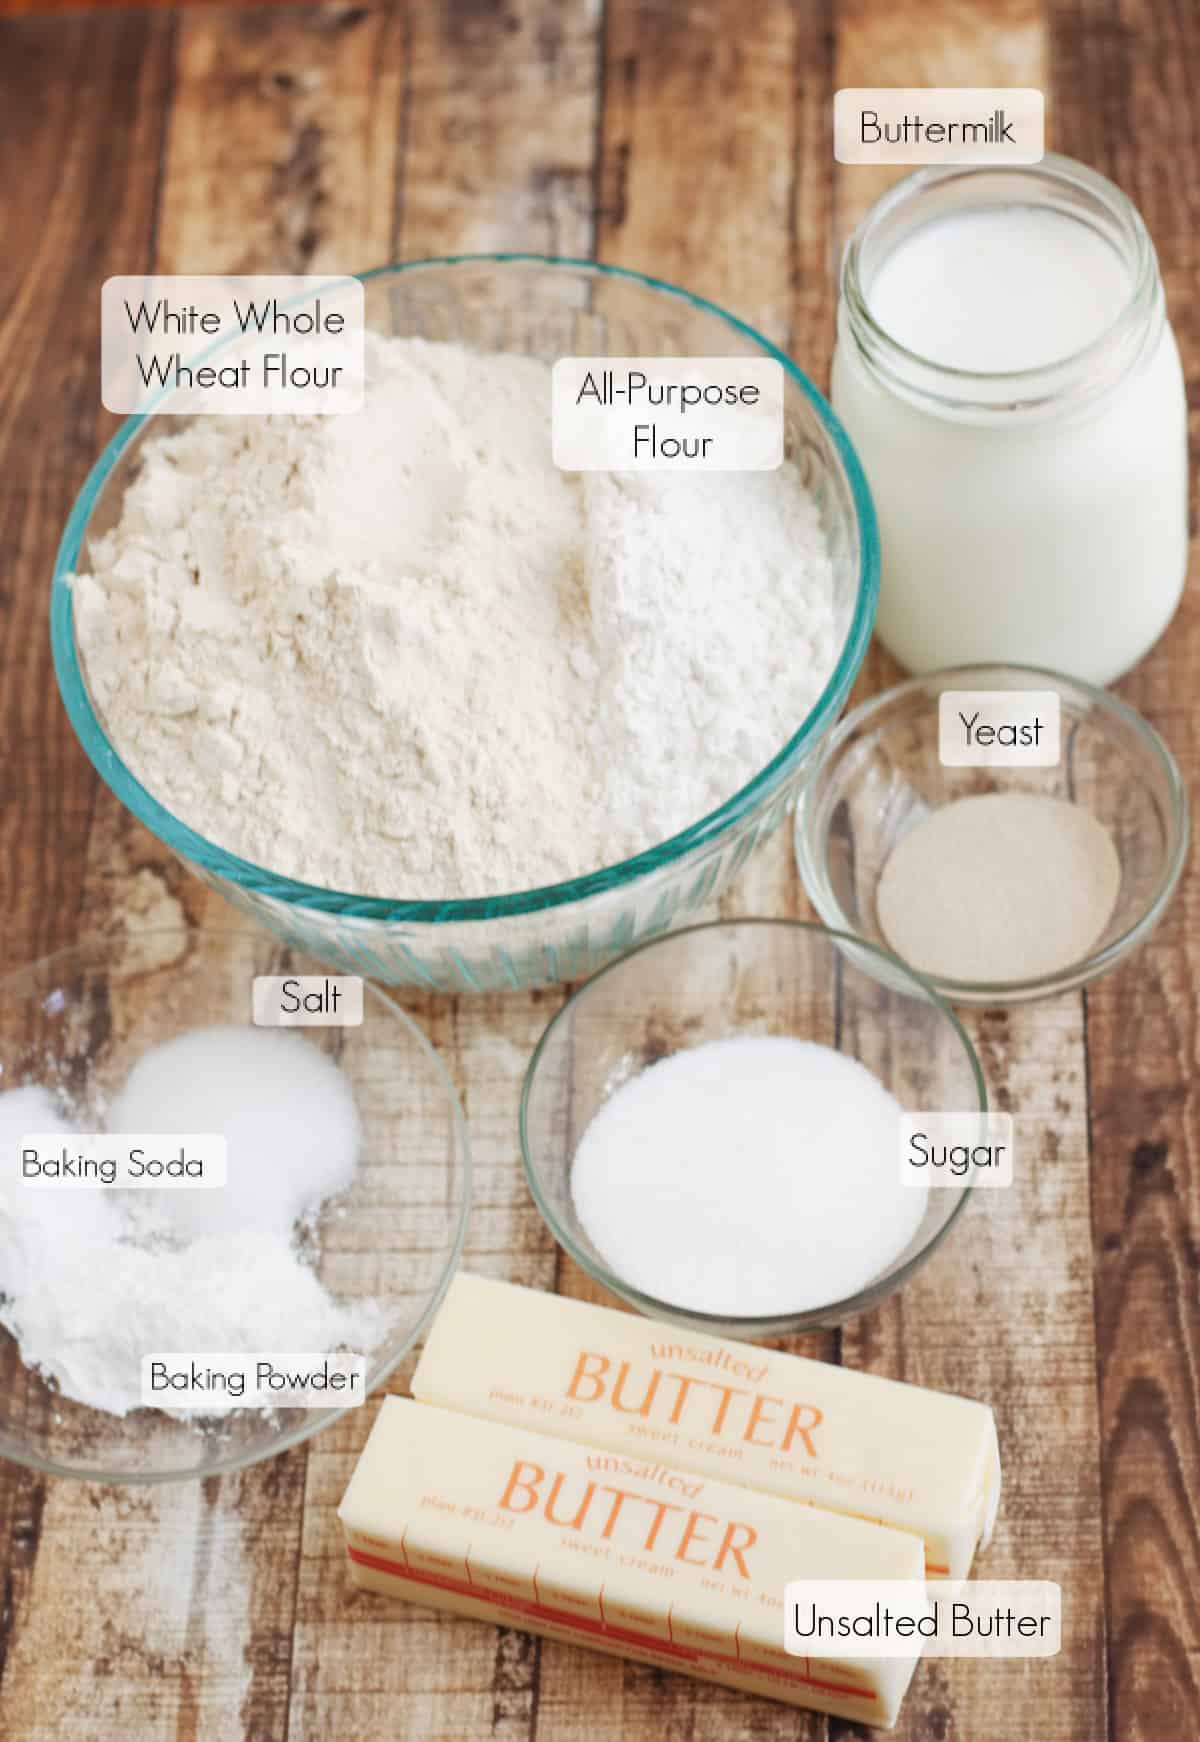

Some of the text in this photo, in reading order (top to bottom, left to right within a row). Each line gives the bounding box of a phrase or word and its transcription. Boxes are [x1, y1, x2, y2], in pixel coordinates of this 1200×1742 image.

[651, 1343, 769, 1384] unsalted
[565, 1351, 823, 1457] BUTTER
[586, 1455, 704, 1499] unsalted
[499, 1460, 757, 1579] BUTTER
